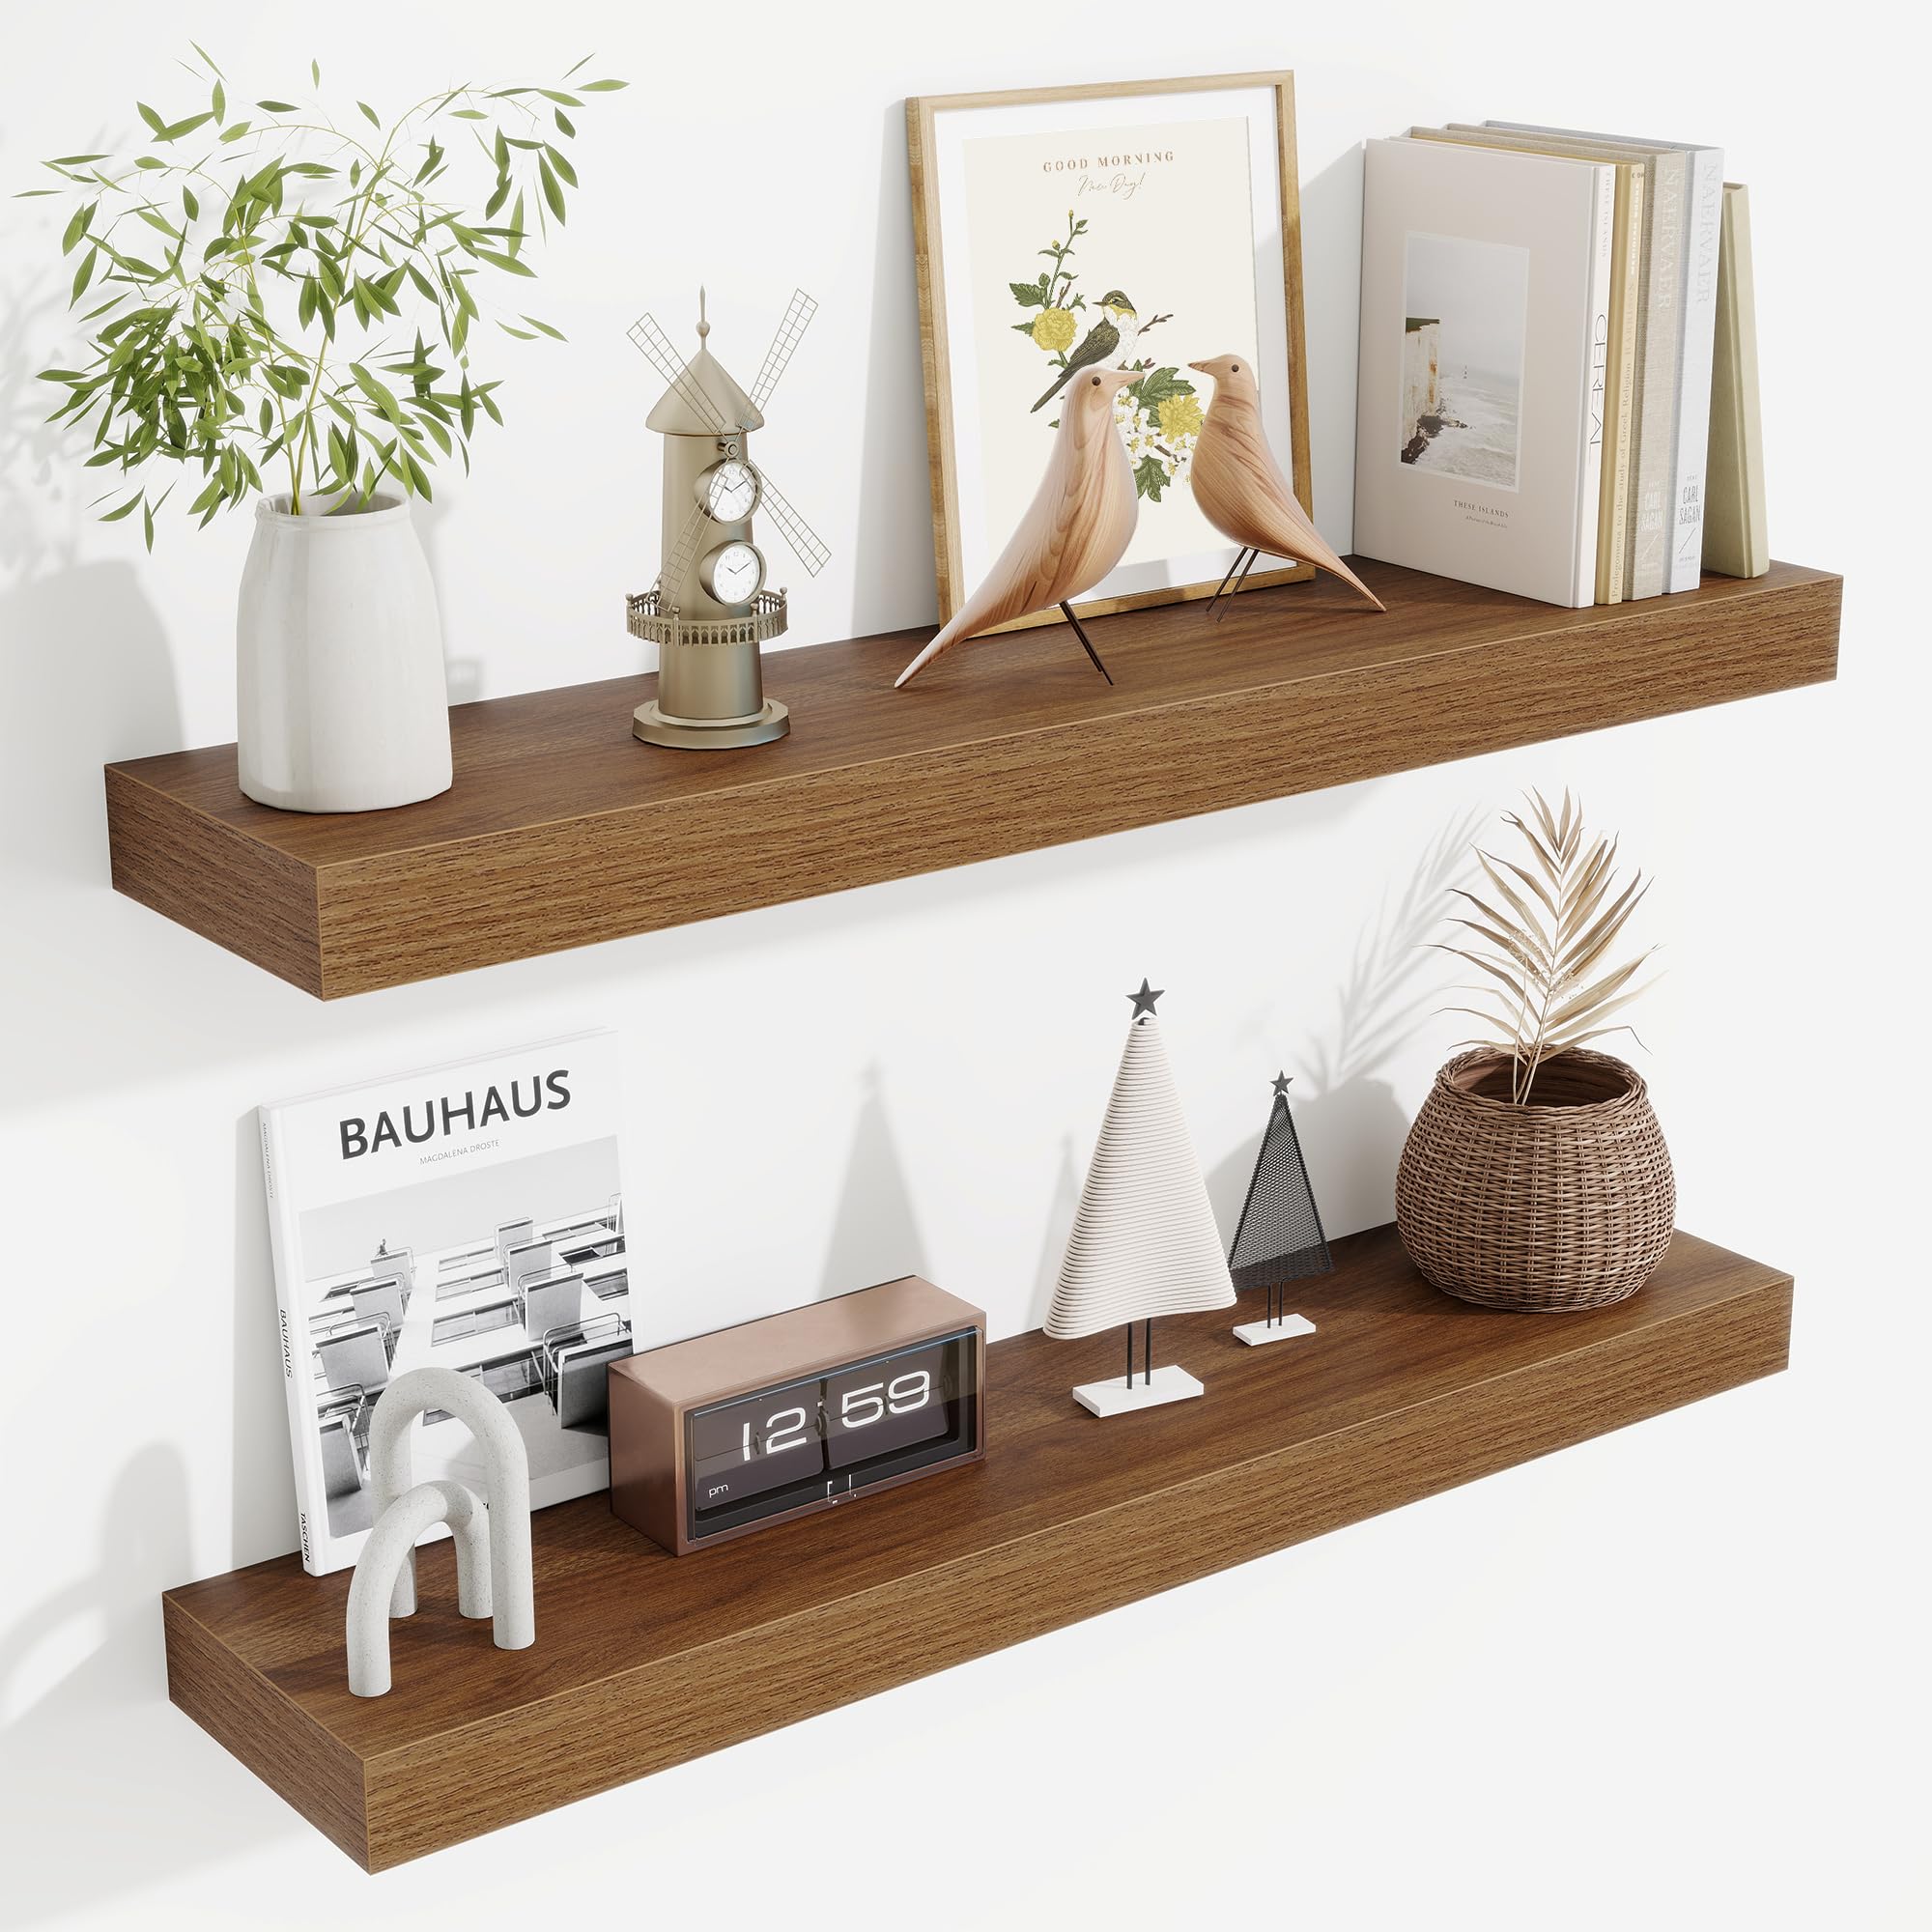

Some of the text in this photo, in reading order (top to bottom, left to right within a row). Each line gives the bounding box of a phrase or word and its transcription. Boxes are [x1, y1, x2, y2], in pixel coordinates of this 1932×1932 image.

[1043, 151, 1174, 172] GOOD MORNING
[1110, 172, 1146, 200] Day!
[1589, 314, 1606, 465] CEREAL
[1623, 362, 1633, 407] Religion
[1620, 448, 1626, 458] of
[1683, 485, 1698, 503] CARL
[1454, 499, 1509, 518] THESE ISLANDS
[1616, 515, 1622, 527] to
[1679, 504, 1700, 525] SAGAN
[1612, 532, 1622, 597] Prolegomena
[339, 1069, 571, 1159] BAUHAUS
[419, 1139, 499, 1165] MAGDALENA DROSTE
[280, 1309, 293, 1378] BAUHAUS
[841, 1370, 930, 1429] 59
[708, 1483, 728, 1498] pm
[300, 1513, 310, 1562] TASCHEN
